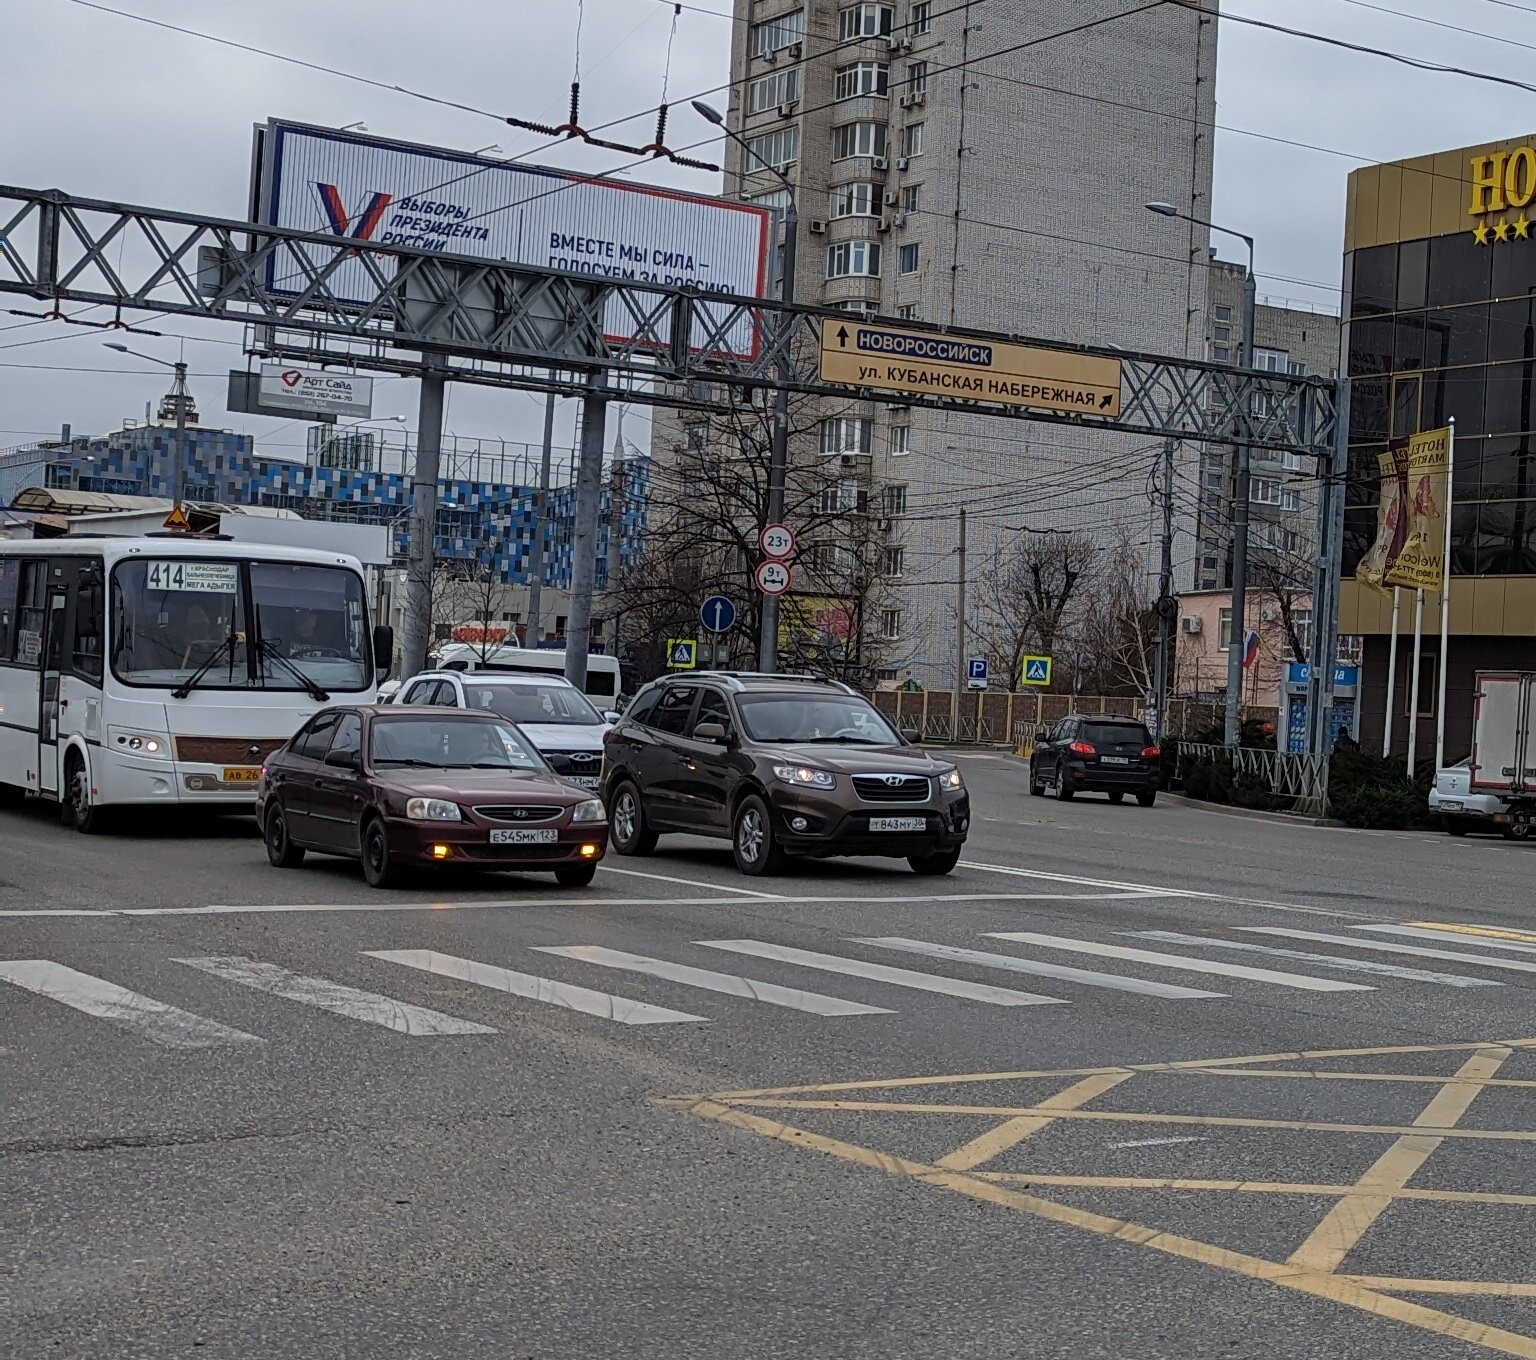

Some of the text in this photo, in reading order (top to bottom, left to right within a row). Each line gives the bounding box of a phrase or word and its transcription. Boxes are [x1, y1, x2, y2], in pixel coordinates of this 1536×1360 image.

[399, 198, 472, 220] ВЫБОРЫ
[380, 231, 448, 252] РОССИИ
[389, 214, 490, 242] ПРЕЗИДЕНТА
[550, 232, 615, 259] ВМЕСТЕ
[619, 243, 647, 264] МЫ
[652, 249, 694, 272] СИЛА
[859, 331, 991, 364] НОВОРОССИЙСК
[858, 366, 1096, 407] ул. КУБАНСКАЯ НАБЕРЕЖНАЯ
[149, 562, 184, 589] 414
[492, 830, 557, 843] Е545МК 123
[873, 819, 912, 830] Т843МУ
